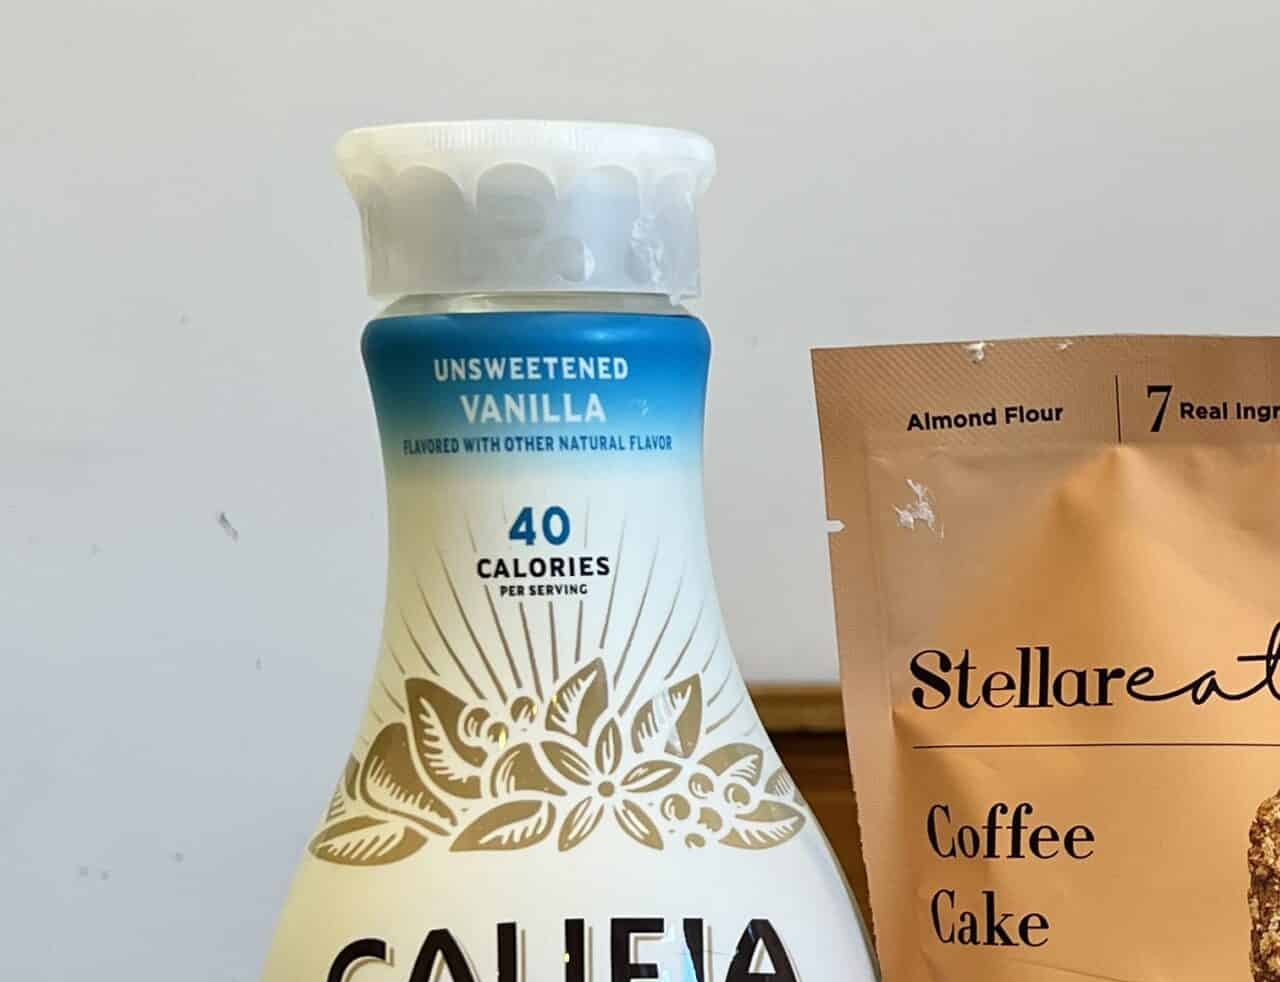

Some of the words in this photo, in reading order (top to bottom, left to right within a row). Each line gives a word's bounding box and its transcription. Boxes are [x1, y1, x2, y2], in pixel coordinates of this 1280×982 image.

[434, 357, 628, 382] UNSWEETENED
[461, 393, 606, 424] VANILLA
[906, 408, 998, 431] Almond
[1005, 403, 1064, 425] Flour
[1145, 385, 1173, 433] 7
[1180, 400, 1229, 421] Real
[403, 438, 459, 455] FLAVORED
[463, 437, 500, 453] WITH
[505, 436, 554, 453] OTHER
[559, 436, 625, 452] NATURAL
[629, 435, 672, 451] FLAVOR
[508, 506, 571, 546] 40
[477, 556, 611, 579] CALORIES
[500, 585, 525, 597] PER
[529, 584, 588, 596] SERVING
[926, 802, 1096, 860] Coffee
[930, 889, 1050, 947] Cake
